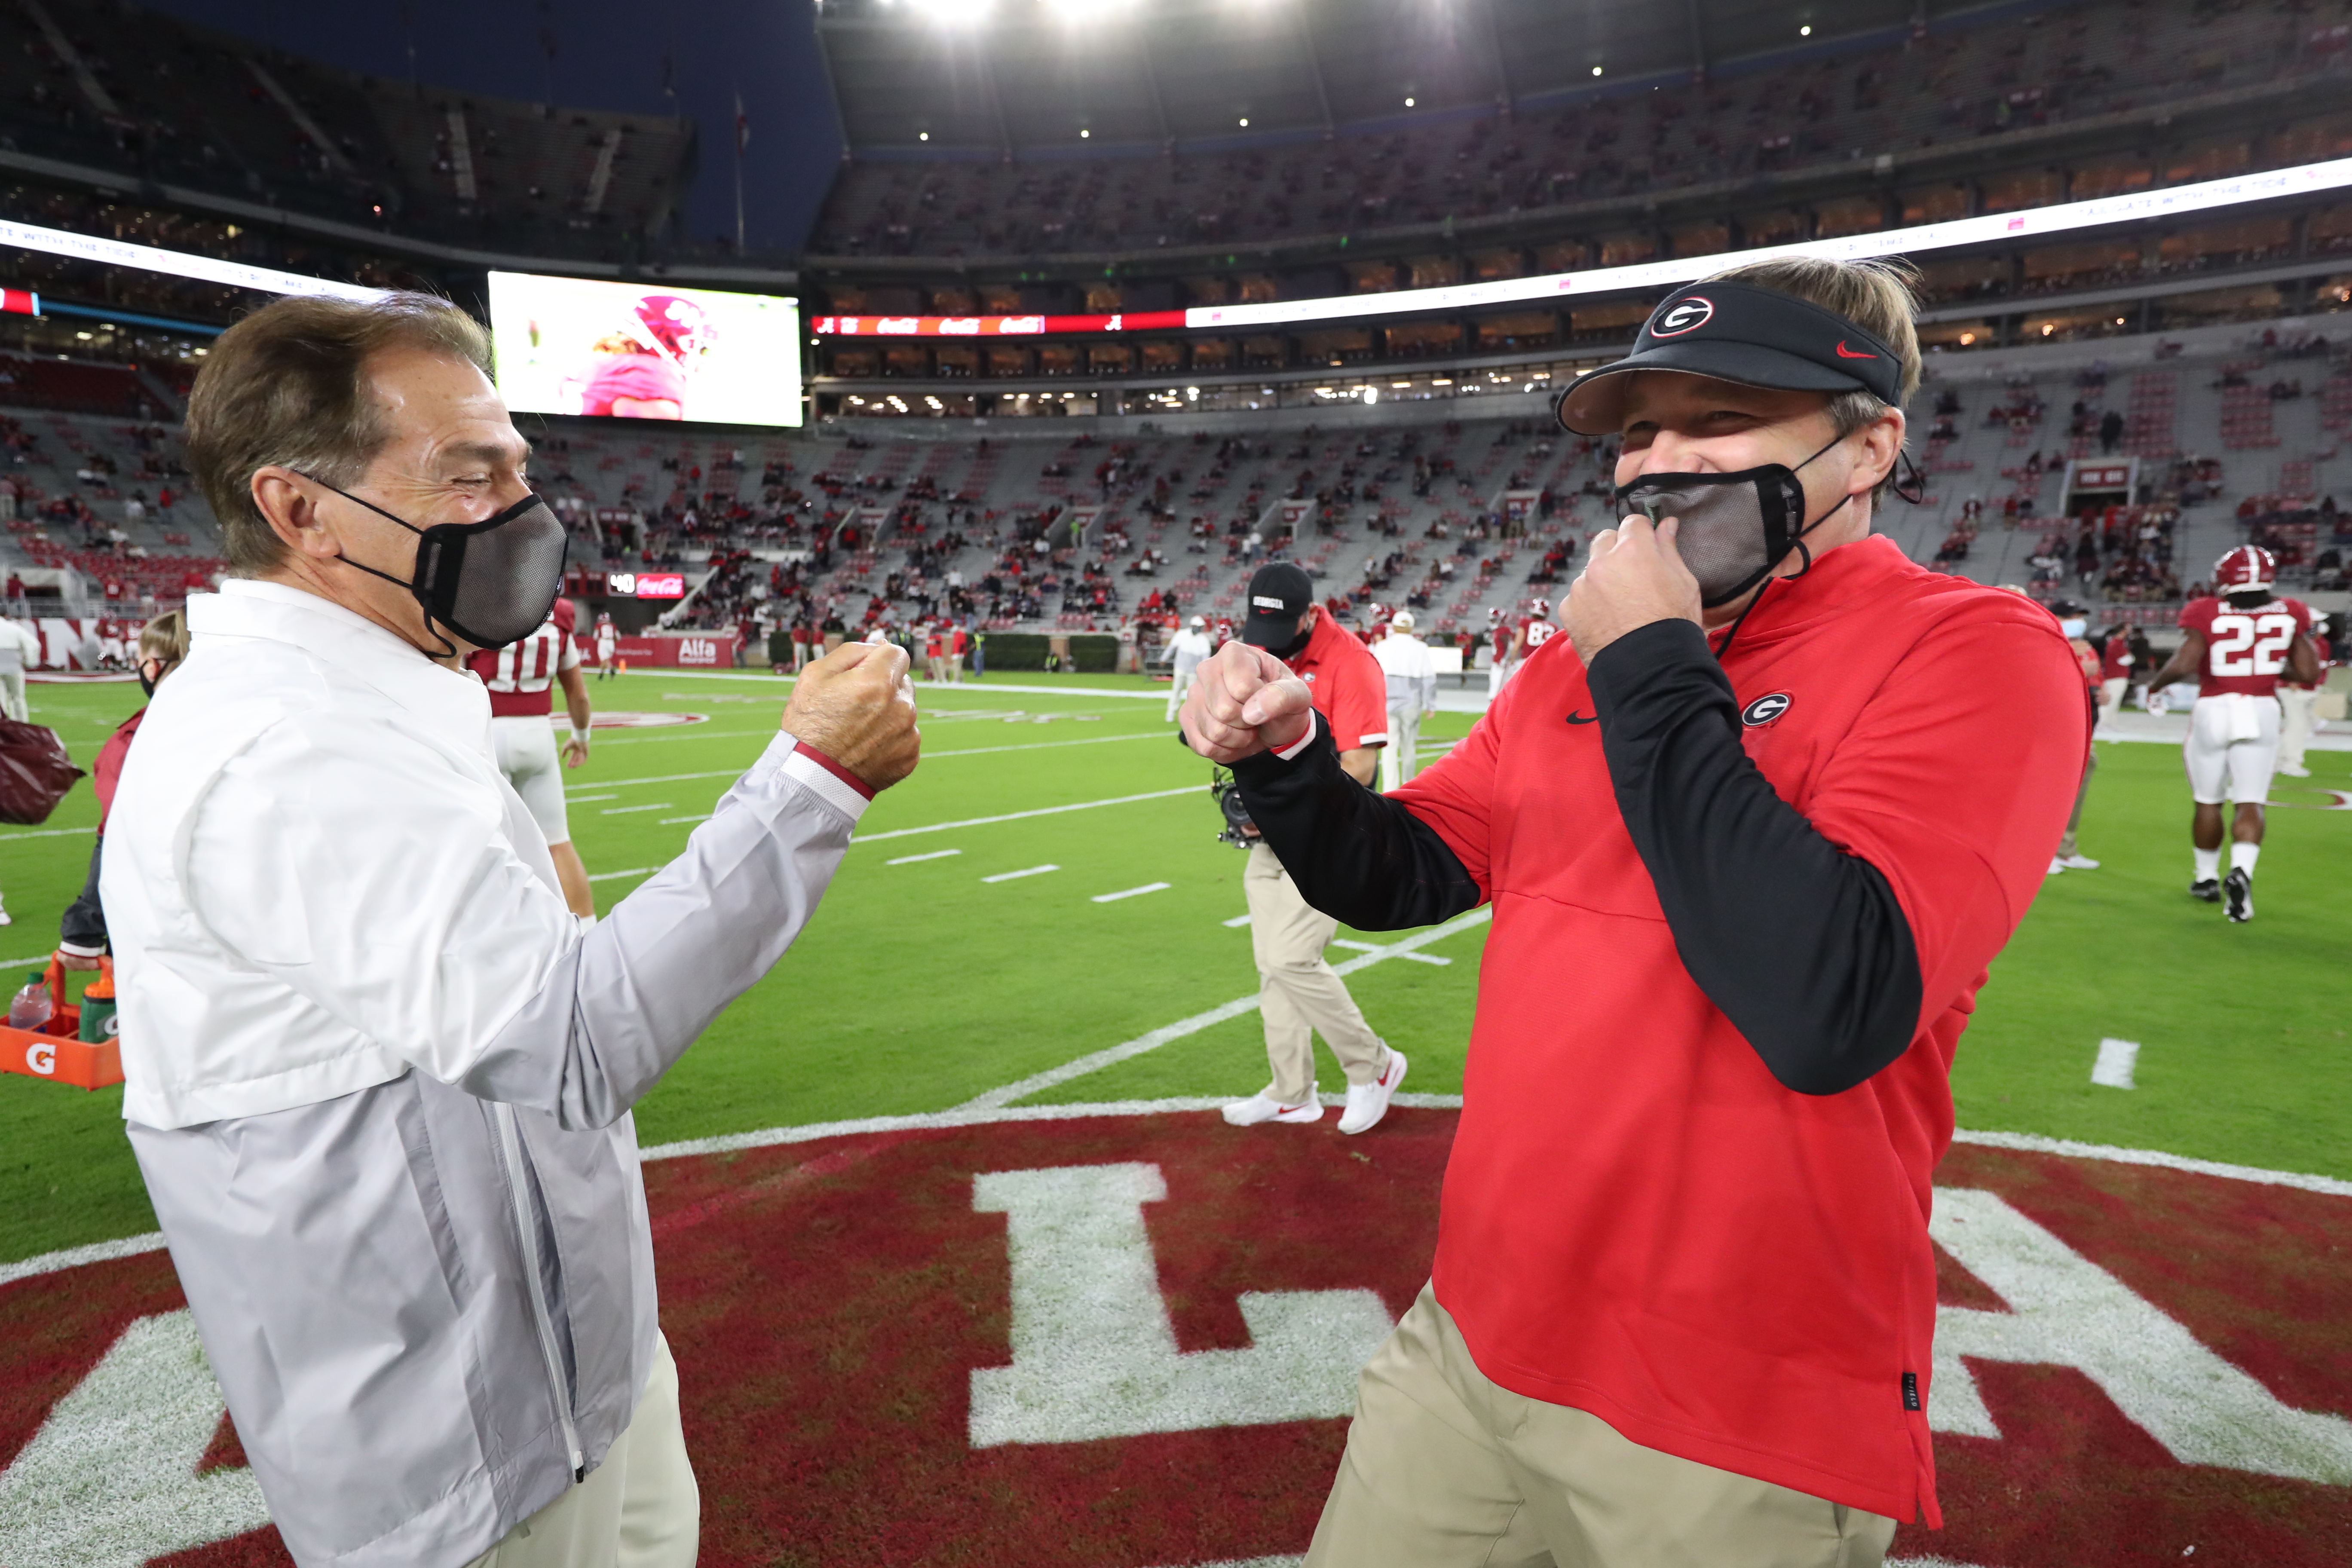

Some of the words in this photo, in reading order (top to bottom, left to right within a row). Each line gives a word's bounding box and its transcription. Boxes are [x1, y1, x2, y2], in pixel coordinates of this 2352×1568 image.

[1650, 296, 1717, 338] G
[610, 574, 635, 593] 40
[1253, 596, 1284, 610] GEORGIA
[487, 622, 560, 693] 10
[679, 638, 717, 658] Alfa
[2210, 614, 2297, 677] 22
[1742, 693, 1789, 726] G
[26, 1042, 57, 1075] G
